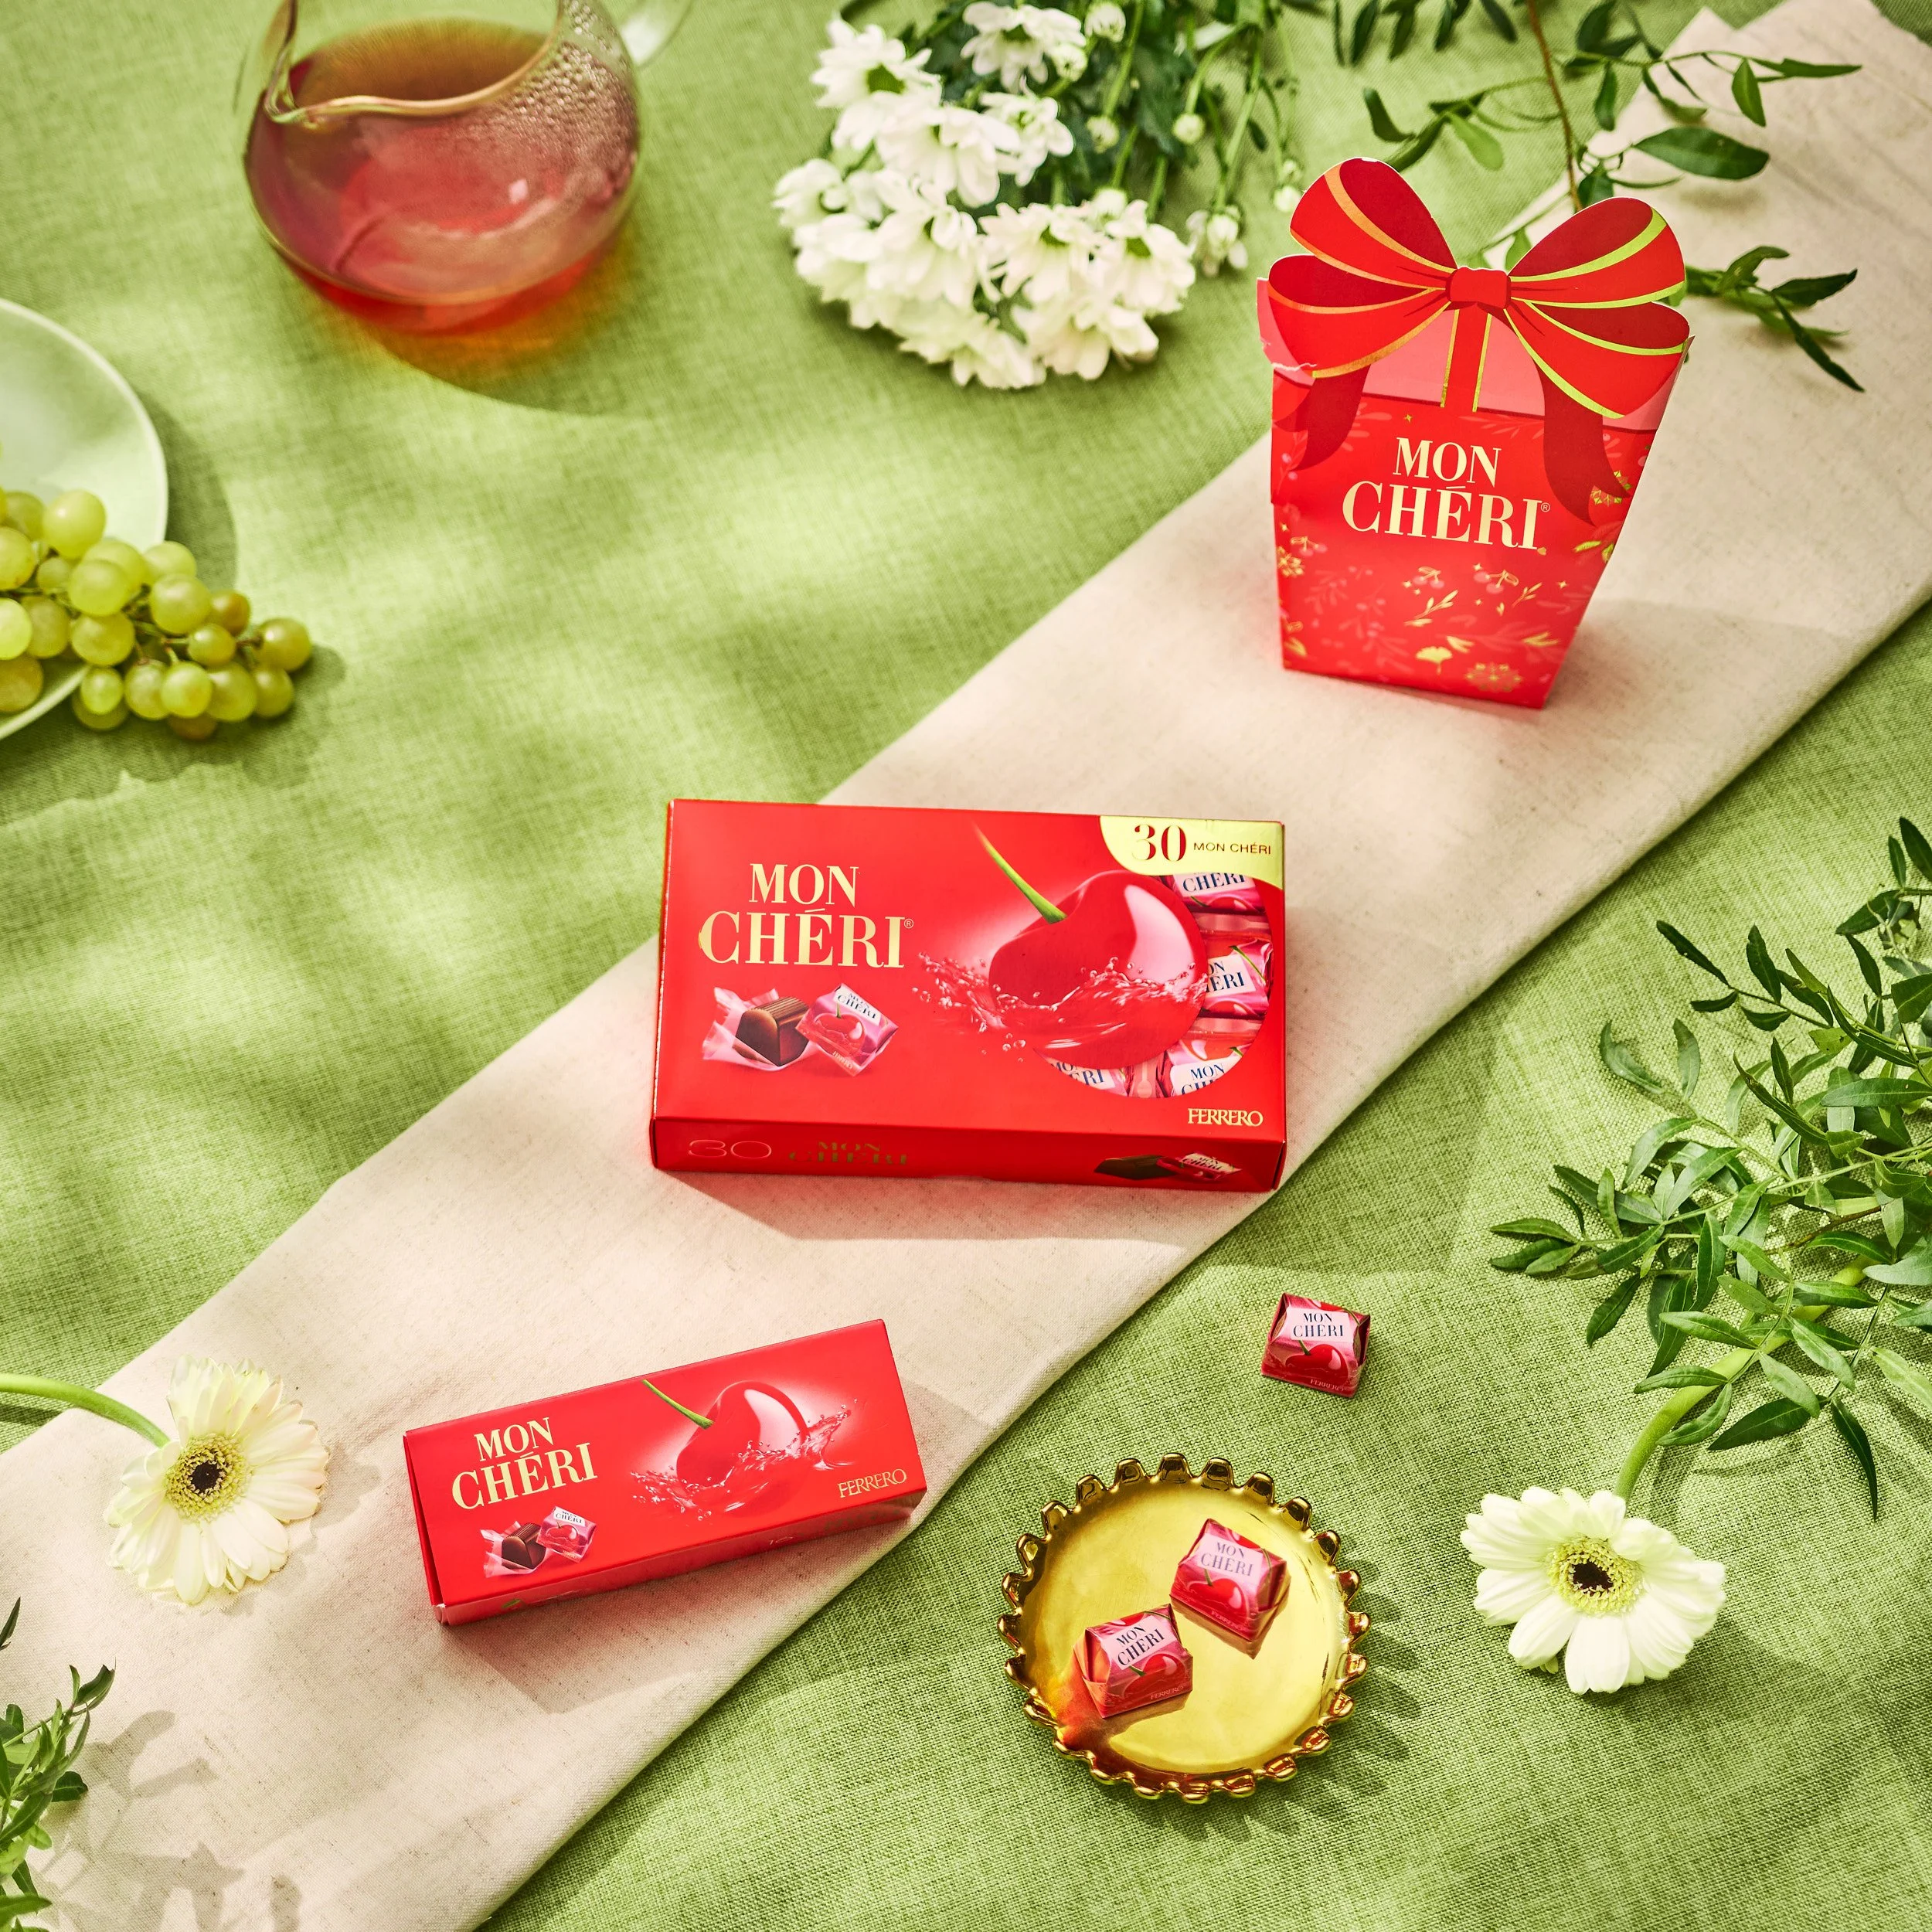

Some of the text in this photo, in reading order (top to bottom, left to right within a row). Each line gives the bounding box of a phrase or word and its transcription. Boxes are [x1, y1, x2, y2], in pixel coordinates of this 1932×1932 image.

[1393, 437, 1502, 488] MON
[1132, 824, 1271, 862] 30 MON CHÉRI
[749, 863, 859, 907] MON
[1190, 1063, 1225, 1080] MON
[1188, 1108, 1263, 1127] FERRERO
[688, 1139, 772, 1158] 30
[1303, 1313, 1332, 1322] MON
[474, 1417, 554, 1462] MON
[451, 1442, 598, 1509] CHÉRI
[838, 1468, 907, 1498] FERRERO
[1217, 1542, 1246, 1559] MON
[1117, 1624, 1146, 1647] MON
